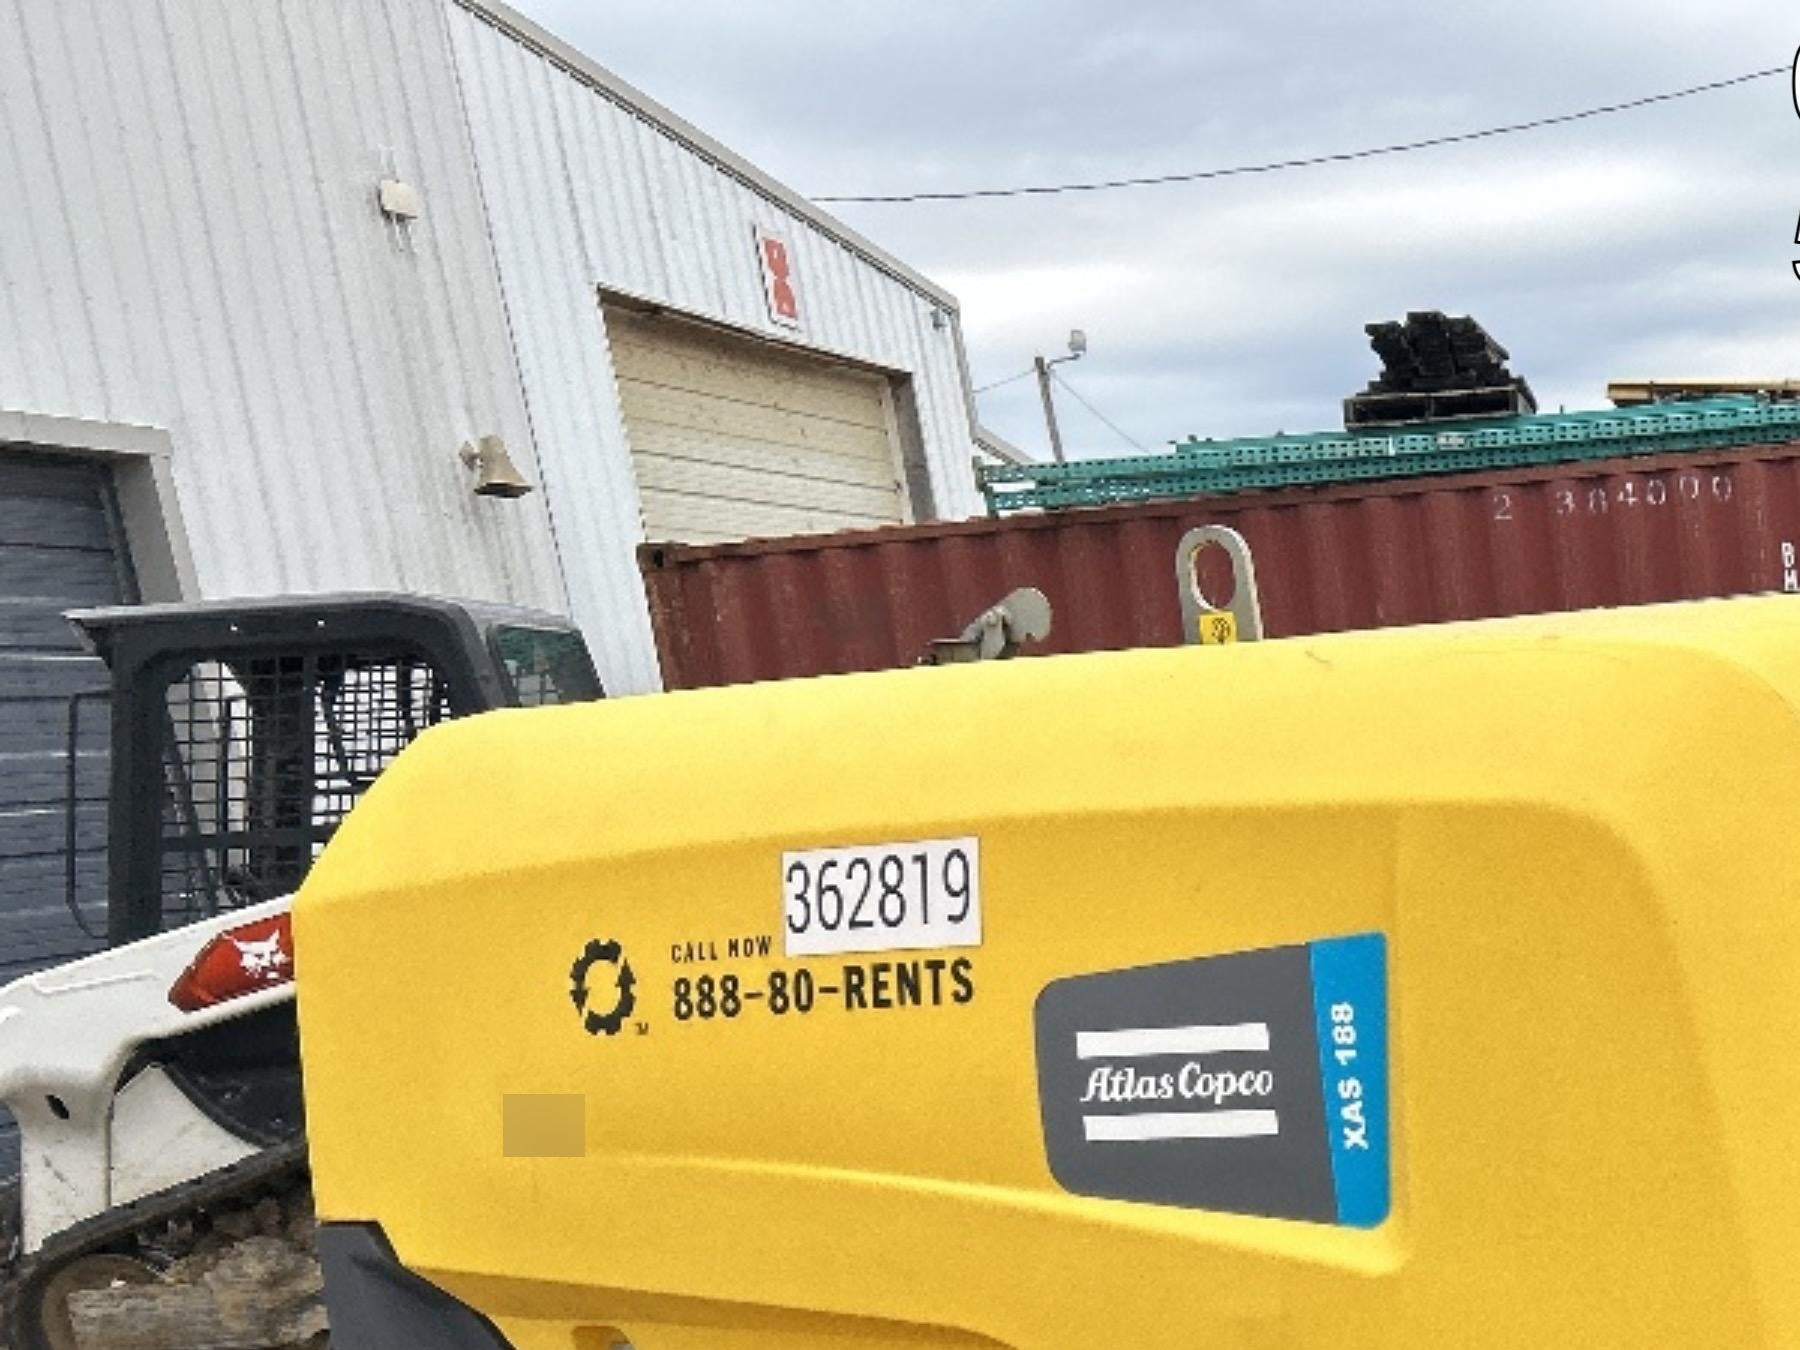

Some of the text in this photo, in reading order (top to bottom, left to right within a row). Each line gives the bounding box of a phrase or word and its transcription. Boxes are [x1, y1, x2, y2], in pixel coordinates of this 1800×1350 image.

[785, 847, 971, 934] 362819
[671, 936, 773, 963] CALL NOW
[673, 957, 975, 1021] 888-80-RENTS
[1080, 1061, 1273, 1105] Atlas Copco
[1330, 1001, 1369, 1151] XAS 188
